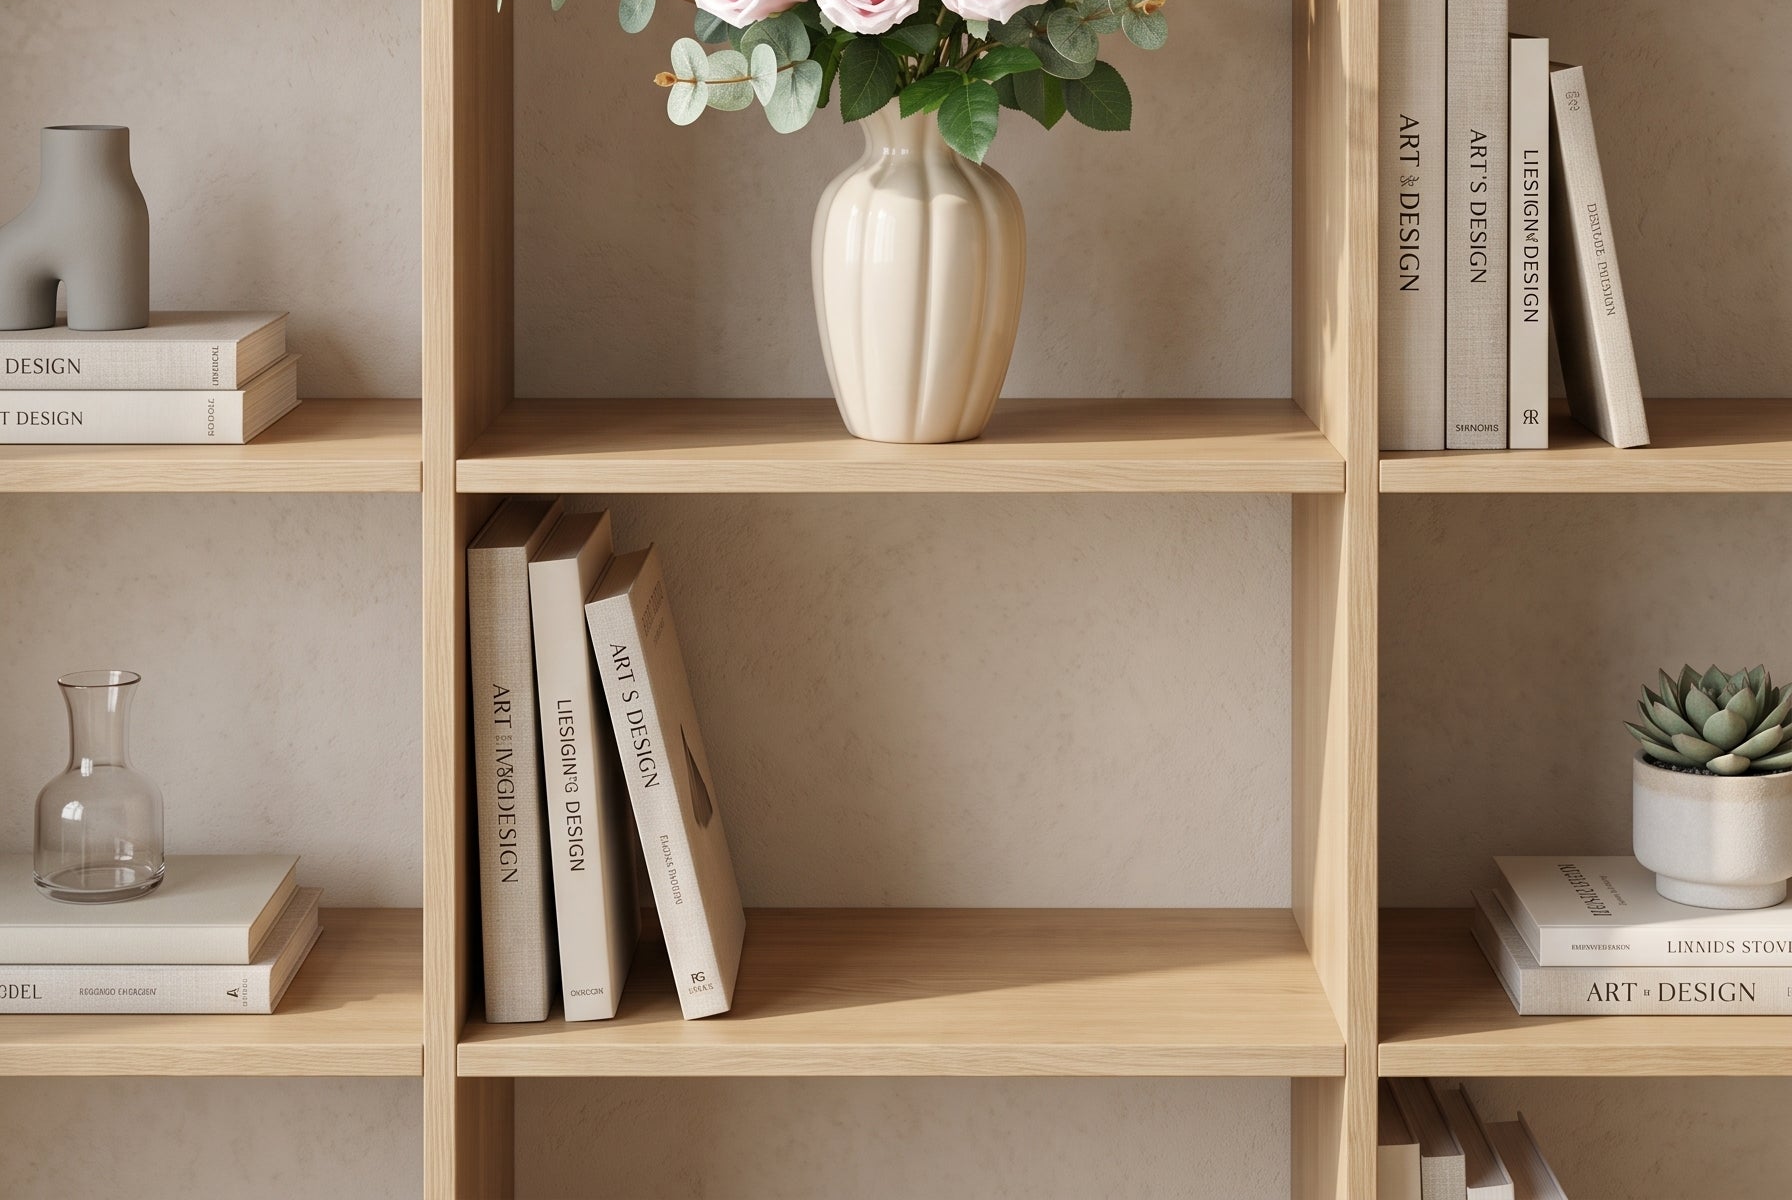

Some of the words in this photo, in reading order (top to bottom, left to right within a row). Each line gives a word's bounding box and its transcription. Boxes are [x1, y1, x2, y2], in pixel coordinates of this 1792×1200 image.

[1400, 114, 1420, 168] ART
[1470, 129, 1487, 193] ART'S
[1400, 193, 1420, 291] DESIGN
[1470, 202, 1487, 284] DESIGN
[1523, 247, 1539, 323] DESIGN
[5, 358, 82, 375] DESIGN
[16, 411, 83, 426] DESIGN
[493, 684, 512, 728] ART
[610, 643, 635, 682] ART
[627, 709, 660, 789] DESIGN
[566, 801, 585, 871] DESIGN
[1587, 982, 1638, 1002] ART
[1658, 982, 1756, 1002] DESIGN
